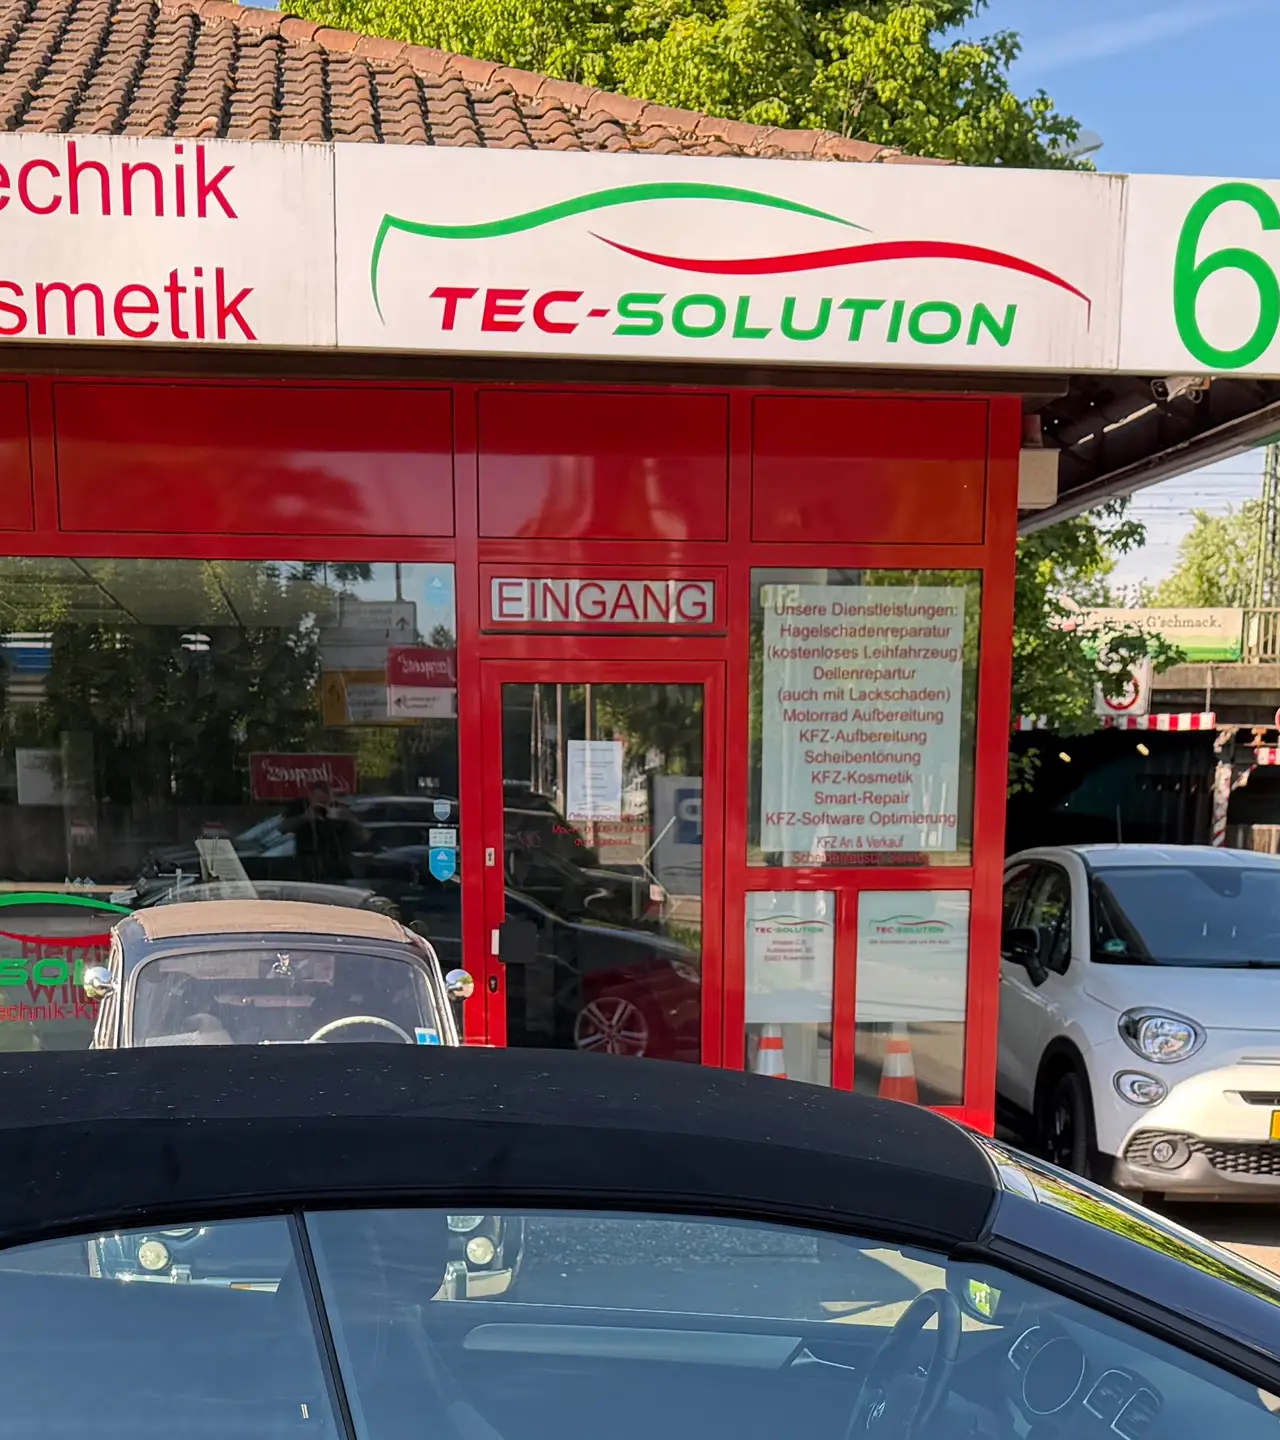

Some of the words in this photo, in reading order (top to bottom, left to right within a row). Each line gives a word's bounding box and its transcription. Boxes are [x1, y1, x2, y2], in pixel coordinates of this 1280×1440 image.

[428, 286, 1017, 348] TEC-SOLUTION
[498, 582, 708, 620] EINGANG
[774, 602, 827, 616] Unsere
[832, 602, 958, 620] Dienstleistungen:
[1147, 615, 1222, 628] G'schmack.
[780, 623, 951, 641] Hagelschadenreparatur
[767, 645, 858, 662] (kostenloses
[864, 645, 964, 662] Leihfahrzeug)
[813, 666, 916, 682] Dellenrepartur
[778, 687, 818, 703] (auch
[823, 687, 845, 701] mit
[849, 687, 951, 703] Lackschaden)
[783, 708, 848, 722] Motorrad
[852, 708, 944, 726] Aufbereitung
[799, 729, 927, 745] KFZ-Aufbereitung
[804, 749, 921, 766] Scheibentönung
[811, 770, 913, 784] KFZ-Kosmetik
[814, 791, 910, 807] Smart-Repair
[765, 811, 865, 826] KFZ-Software
[869, 811, 957, 828] Optimierung
